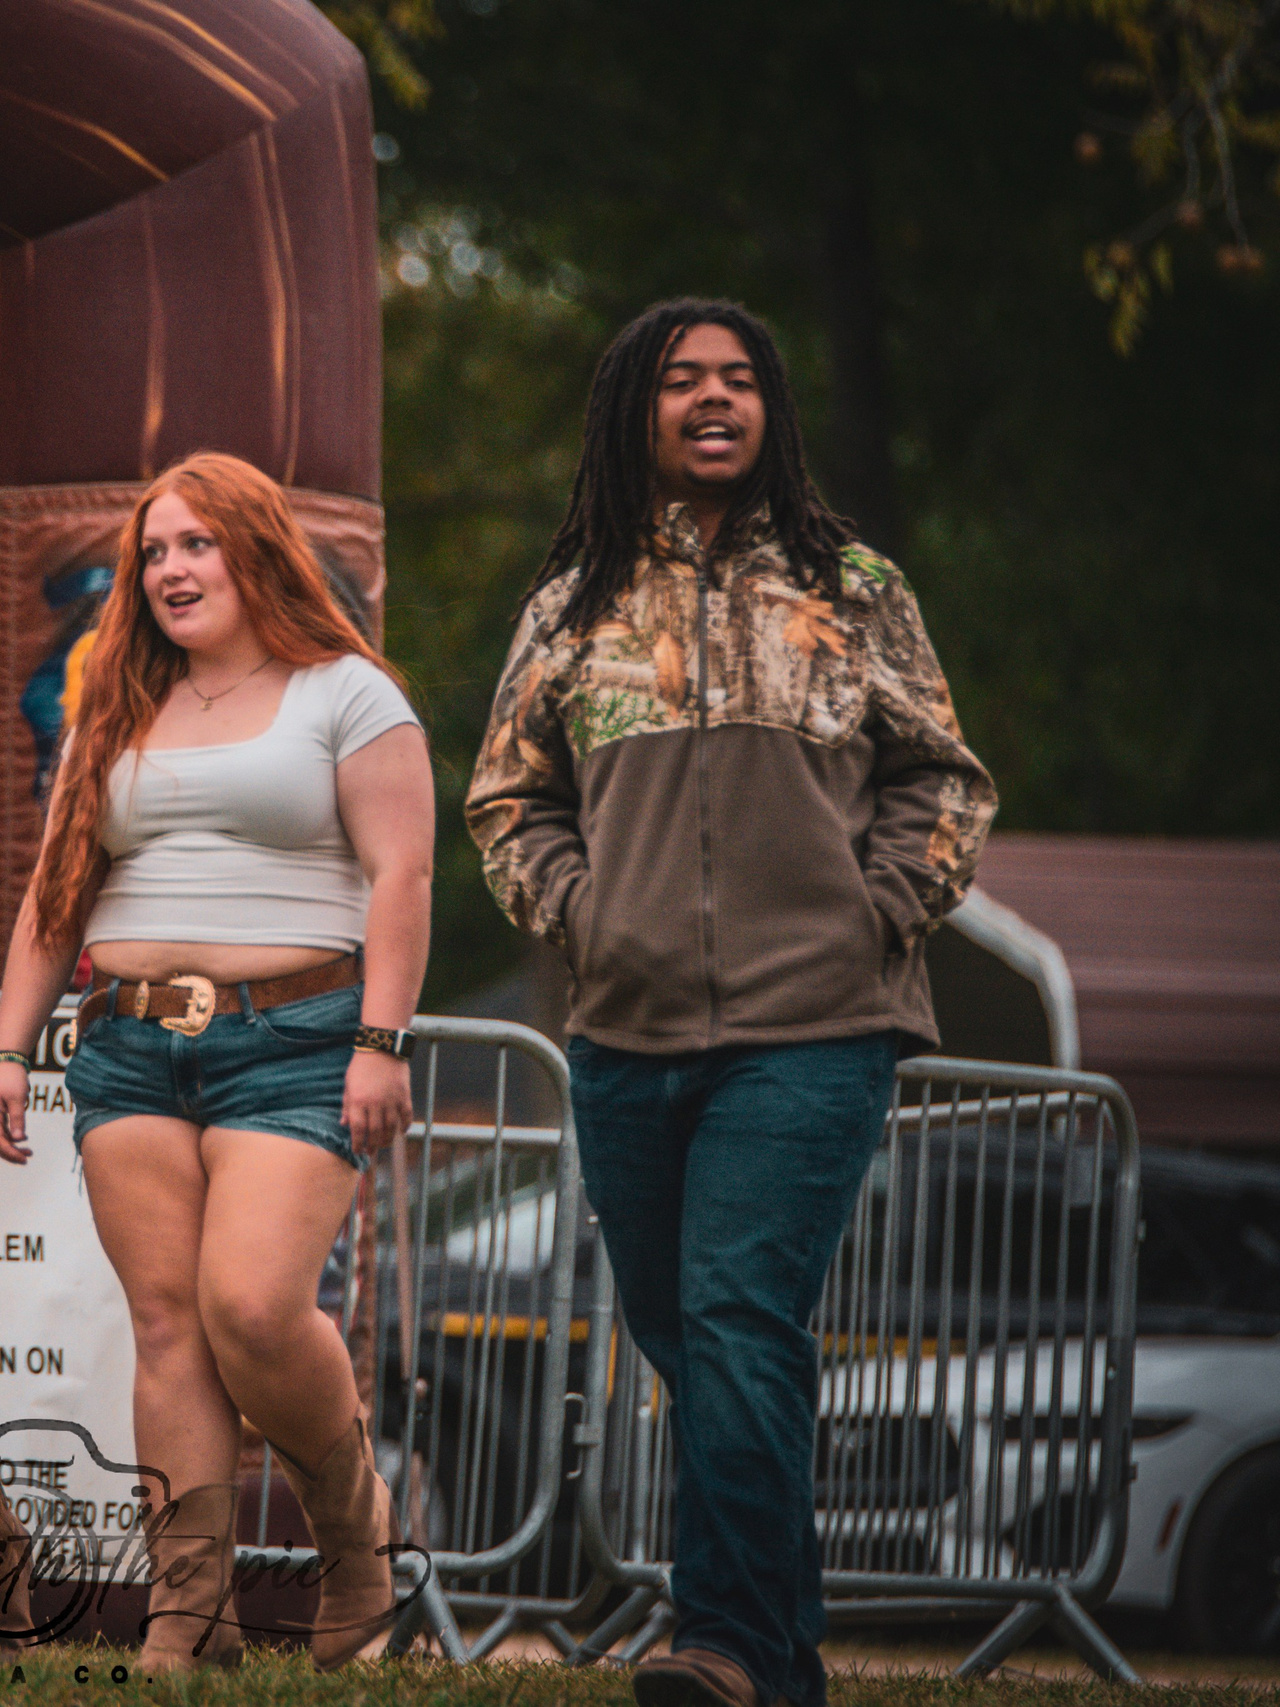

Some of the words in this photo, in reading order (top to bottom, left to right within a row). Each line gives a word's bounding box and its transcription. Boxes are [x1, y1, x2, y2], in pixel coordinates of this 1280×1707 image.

[24, 1085, 74, 1113] HA
[26, 1346, 64, 1376] ON
[24, 1459, 68, 1490] THE
[59, 1538, 114, 1568] FALL
